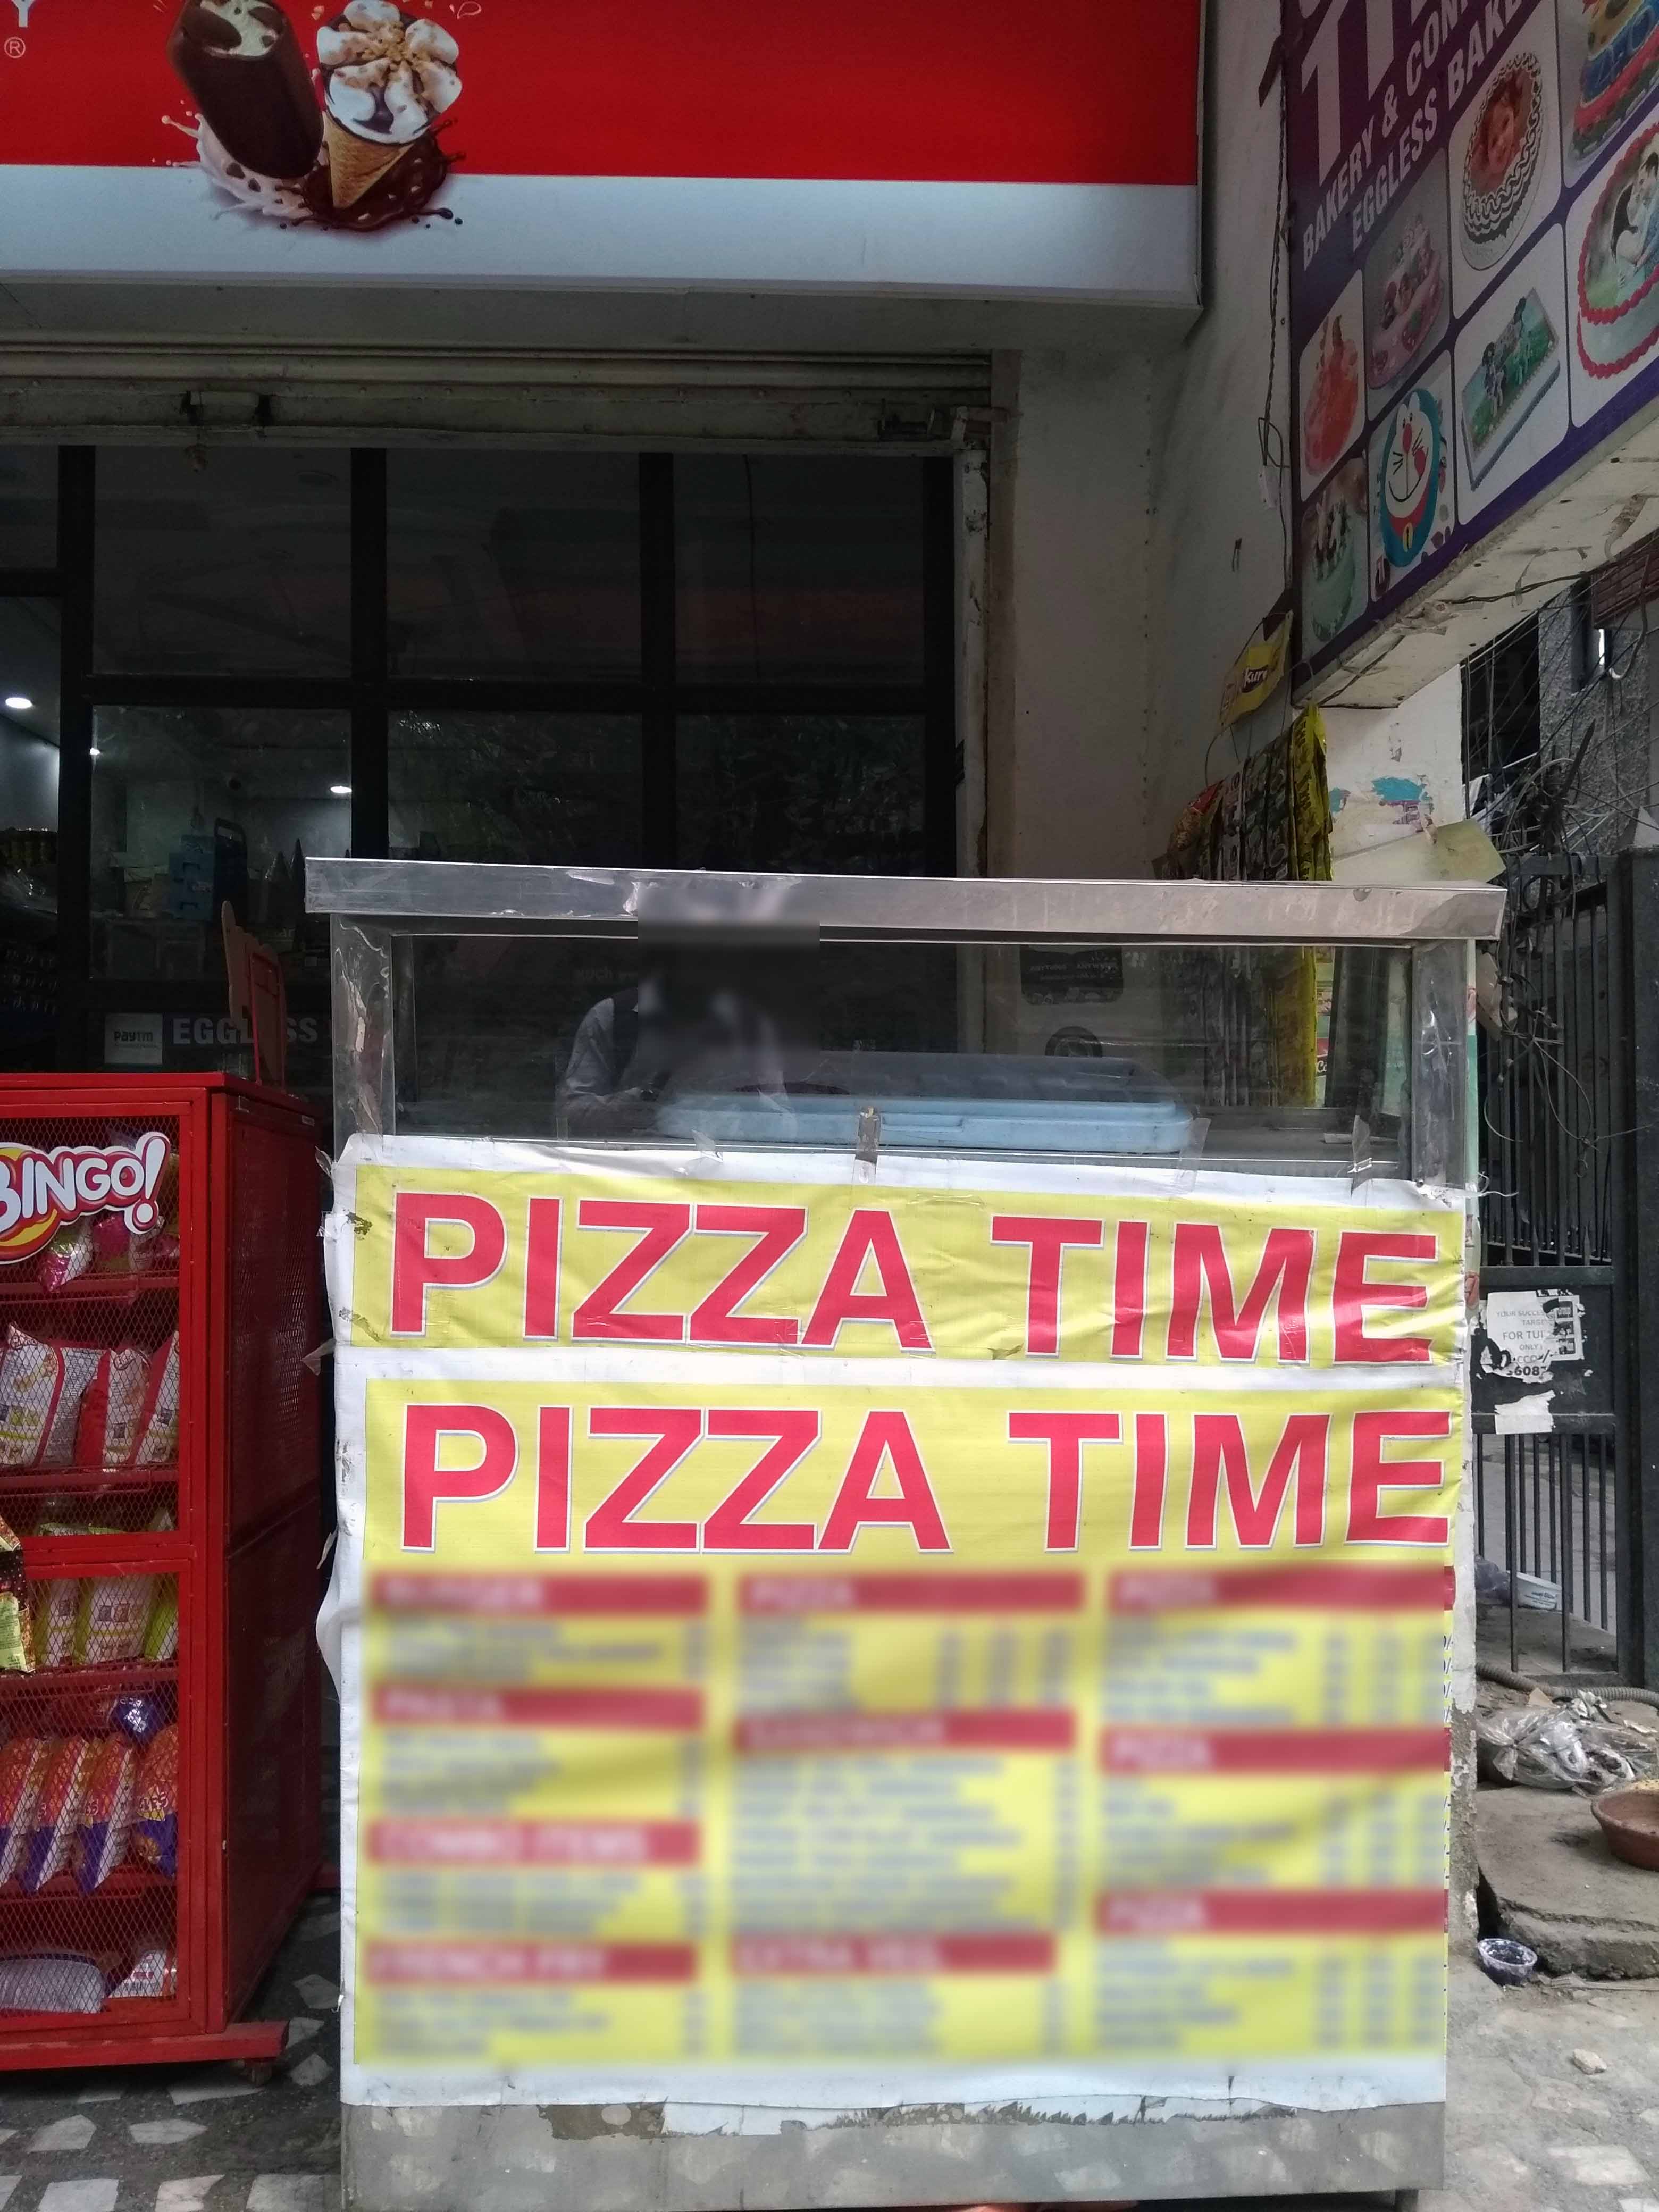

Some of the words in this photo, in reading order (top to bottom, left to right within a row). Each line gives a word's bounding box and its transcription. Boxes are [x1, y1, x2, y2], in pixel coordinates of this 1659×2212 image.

[1303, 114, 1375, 271] BAKERY
[1382, 83, 1398, 138] &
[1352, 87, 1437, 252] EGGLESS
[172, 1017, 319, 1045] EGGLSS
[388, 1191, 936, 1354] PIZZA
[989, 1213, 1439, 1367] TIME
[1503, 1330, 1523, 1340] FOR
[401, 1403, 955, 1554] PIZZA
[1007, 1410, 1454, 1552] TIME
